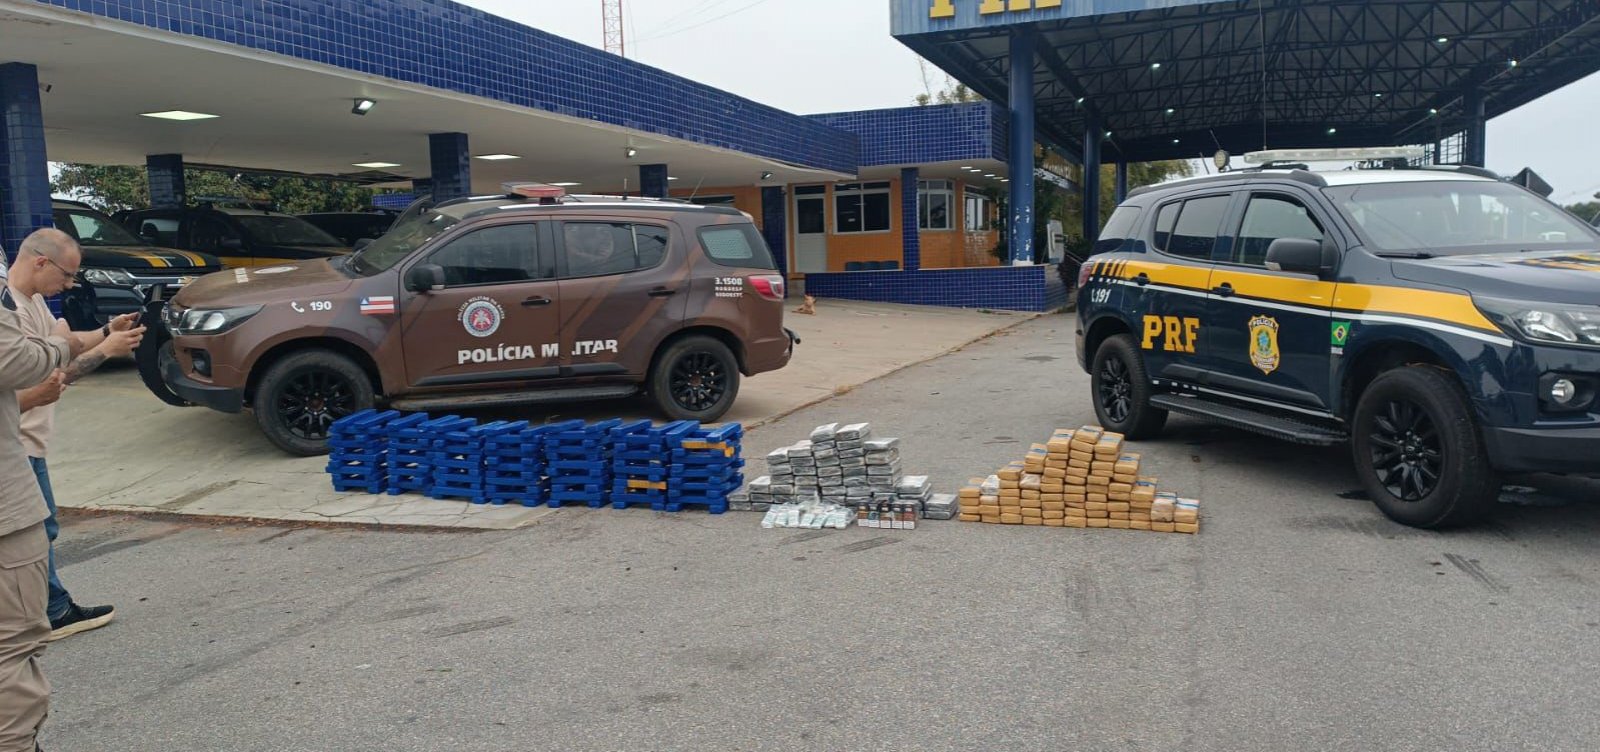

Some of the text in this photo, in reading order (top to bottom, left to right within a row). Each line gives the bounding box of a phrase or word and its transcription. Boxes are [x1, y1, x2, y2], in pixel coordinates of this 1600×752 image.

[309, 300, 332, 311] 190
[1095, 288, 1111, 303] 191
[1141, 315, 1199, 353] PRF
[457, 339, 618, 365] POLÍCIA MITAR
